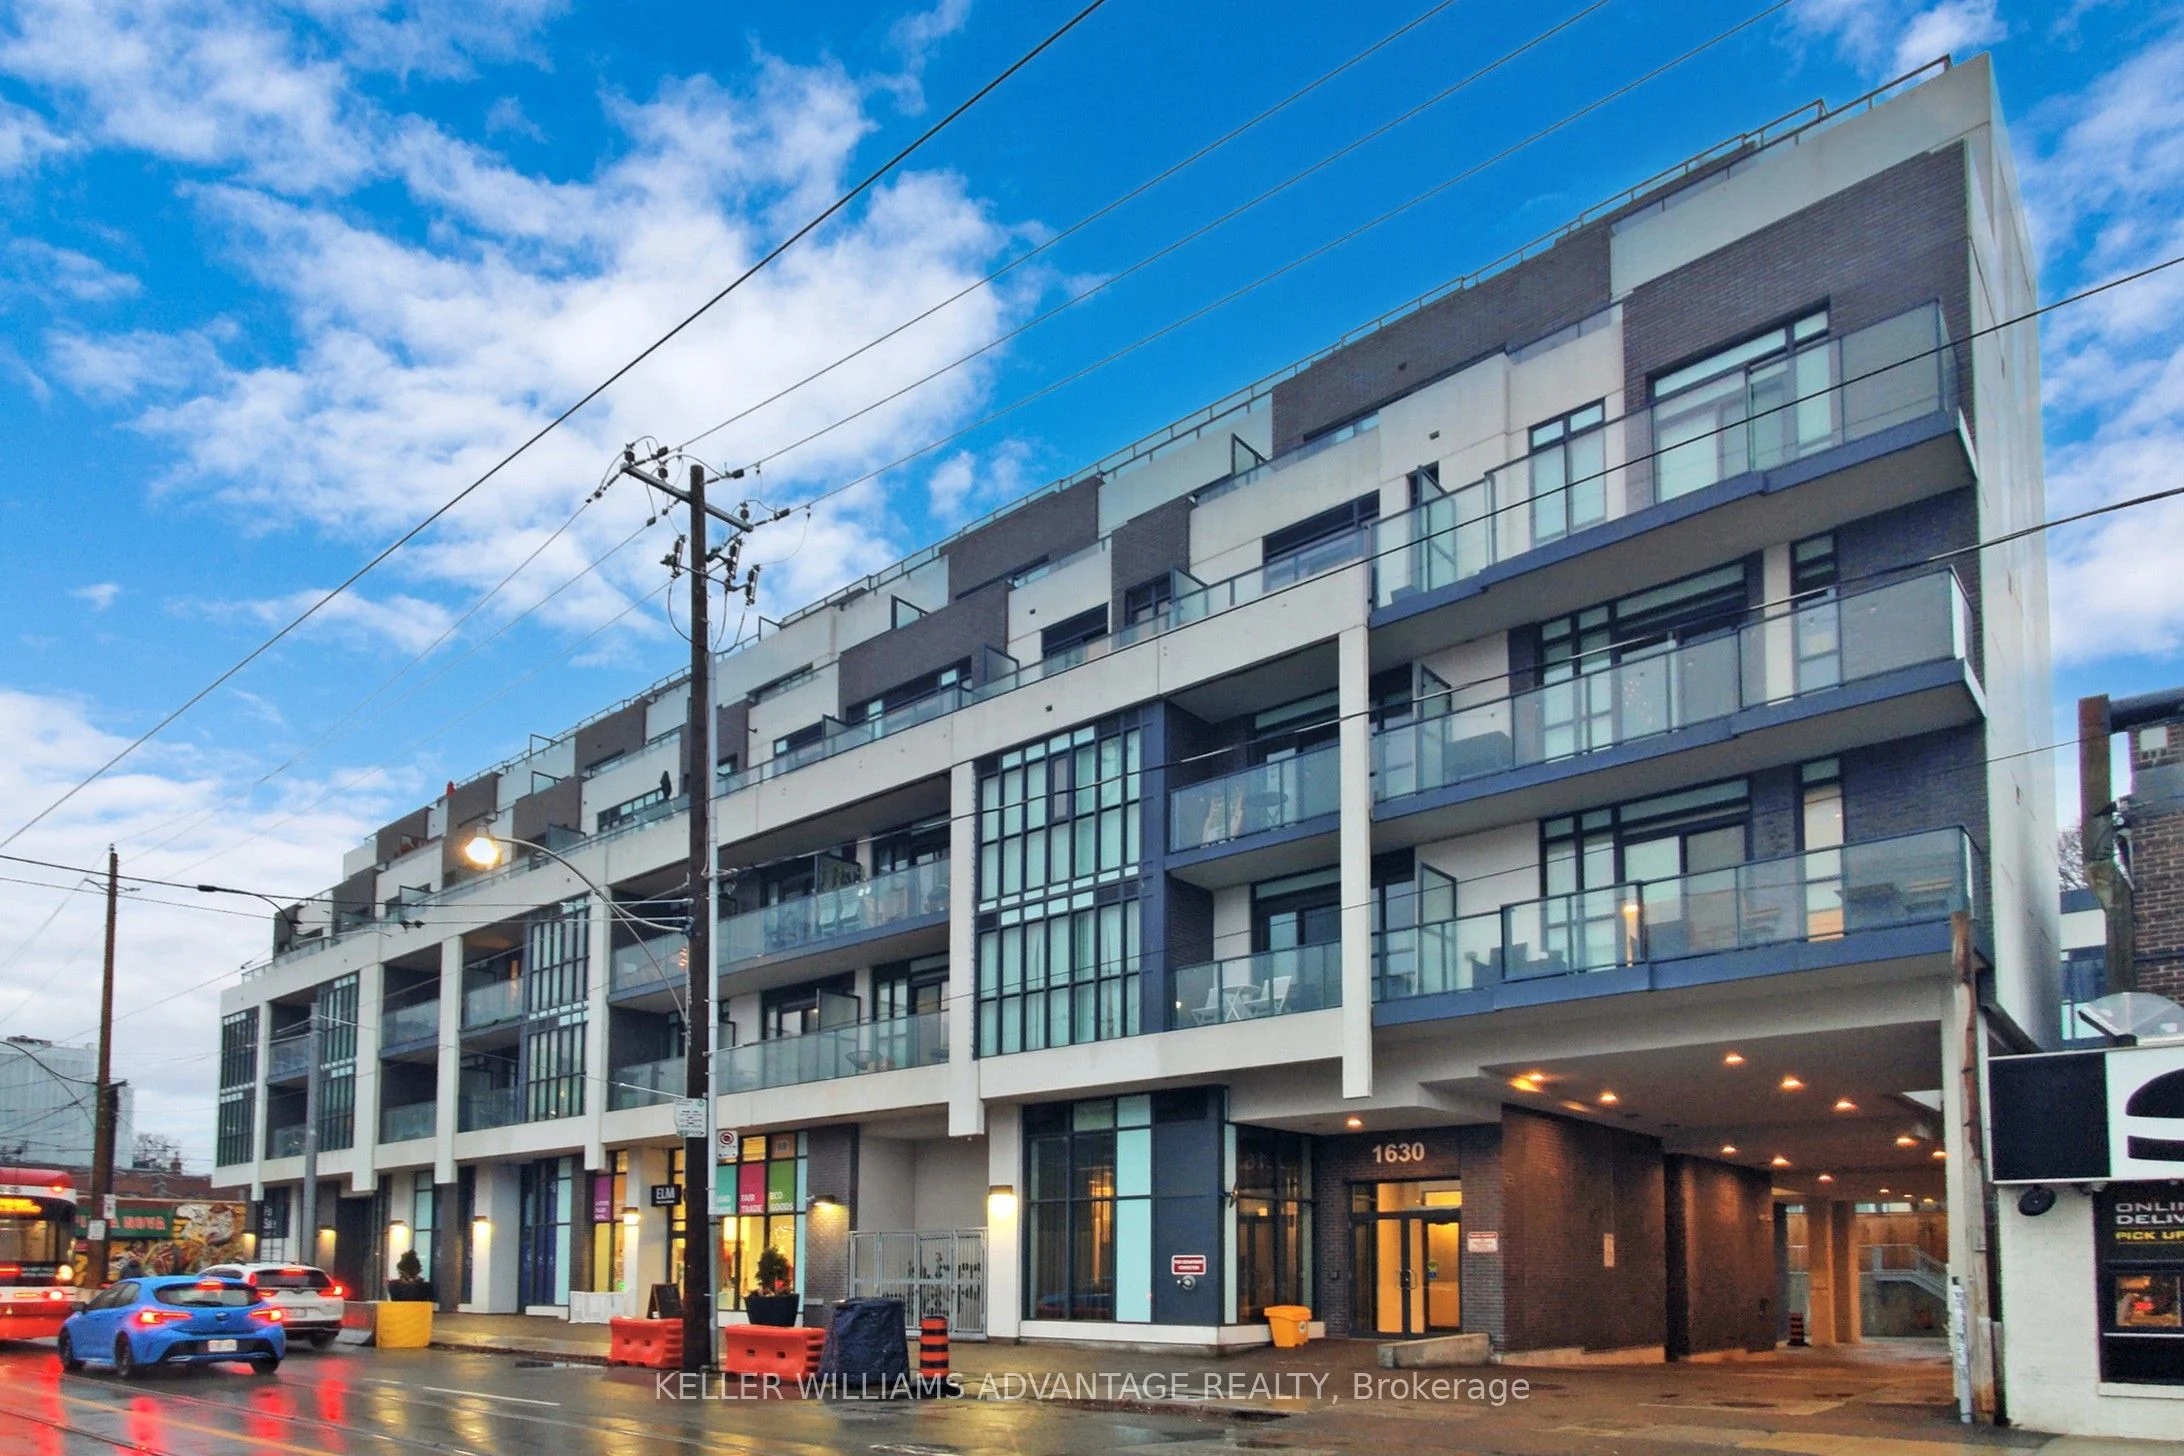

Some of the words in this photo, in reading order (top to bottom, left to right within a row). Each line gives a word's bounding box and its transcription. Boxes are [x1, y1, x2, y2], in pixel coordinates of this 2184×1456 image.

[1372, 1142, 1425, 1163] 1630
[656, 1187, 675, 1199] ELM
[769, 1192, 783, 1200] ECO
[2115, 1231, 2156, 1240] PICK
